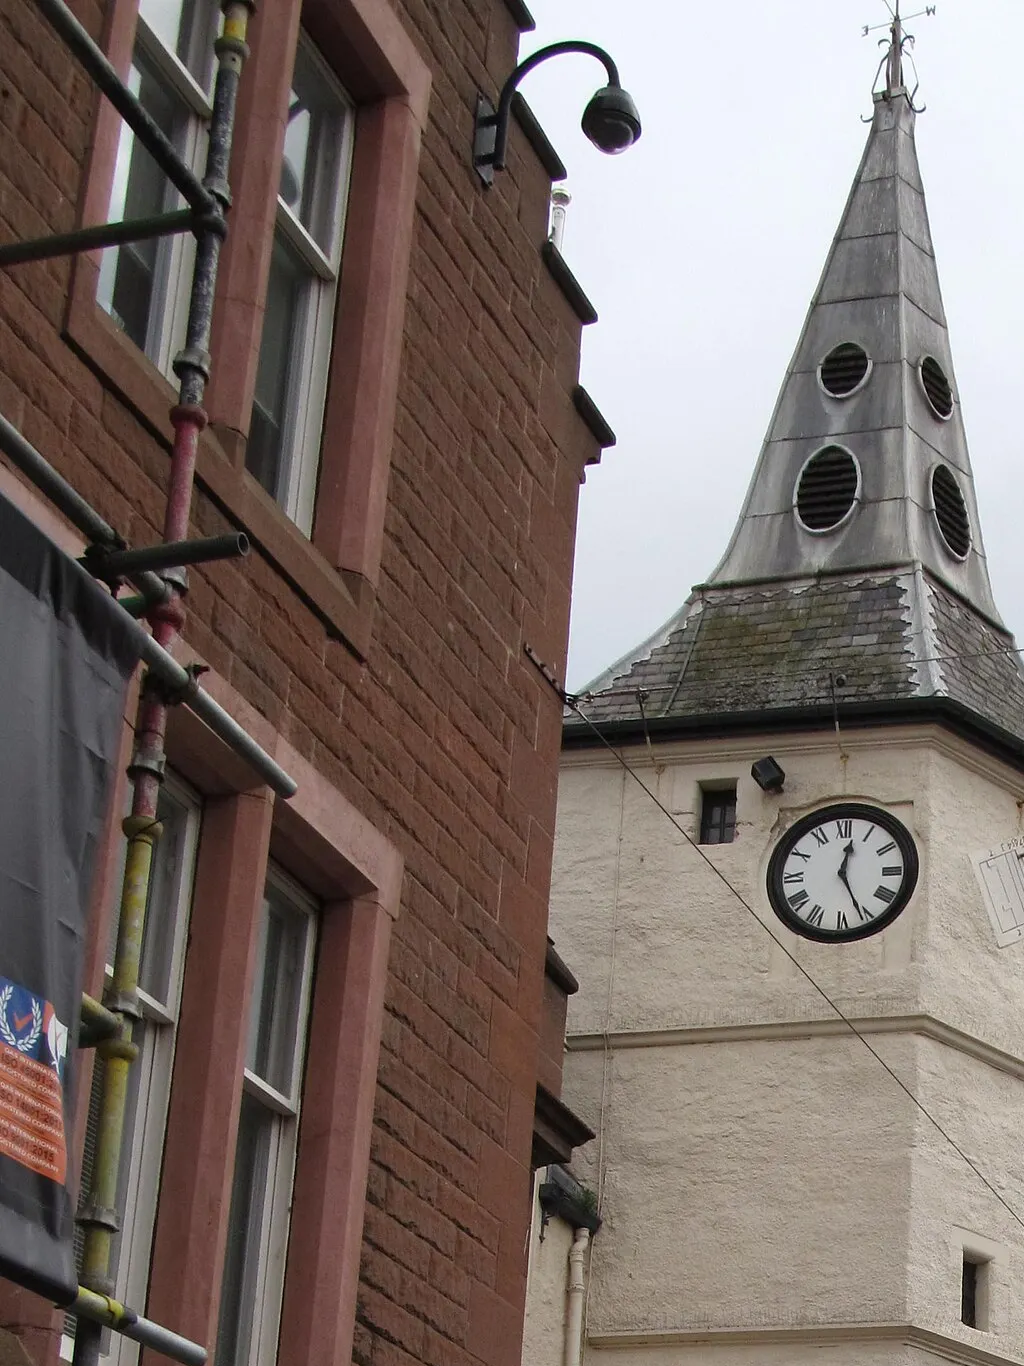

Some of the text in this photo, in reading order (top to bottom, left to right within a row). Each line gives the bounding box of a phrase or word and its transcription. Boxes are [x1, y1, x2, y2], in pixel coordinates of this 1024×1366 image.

[811, 827, 829, 847] XI
[836, 820, 852, 839] XII
[791, 848, 811, 862] X
[876, 841, 896, 856] II
[784, 872, 804, 884] IX
[882, 866, 902, 876] III
[806, 904, 825, 927] VII
[837, 911, 849, 929] VI
